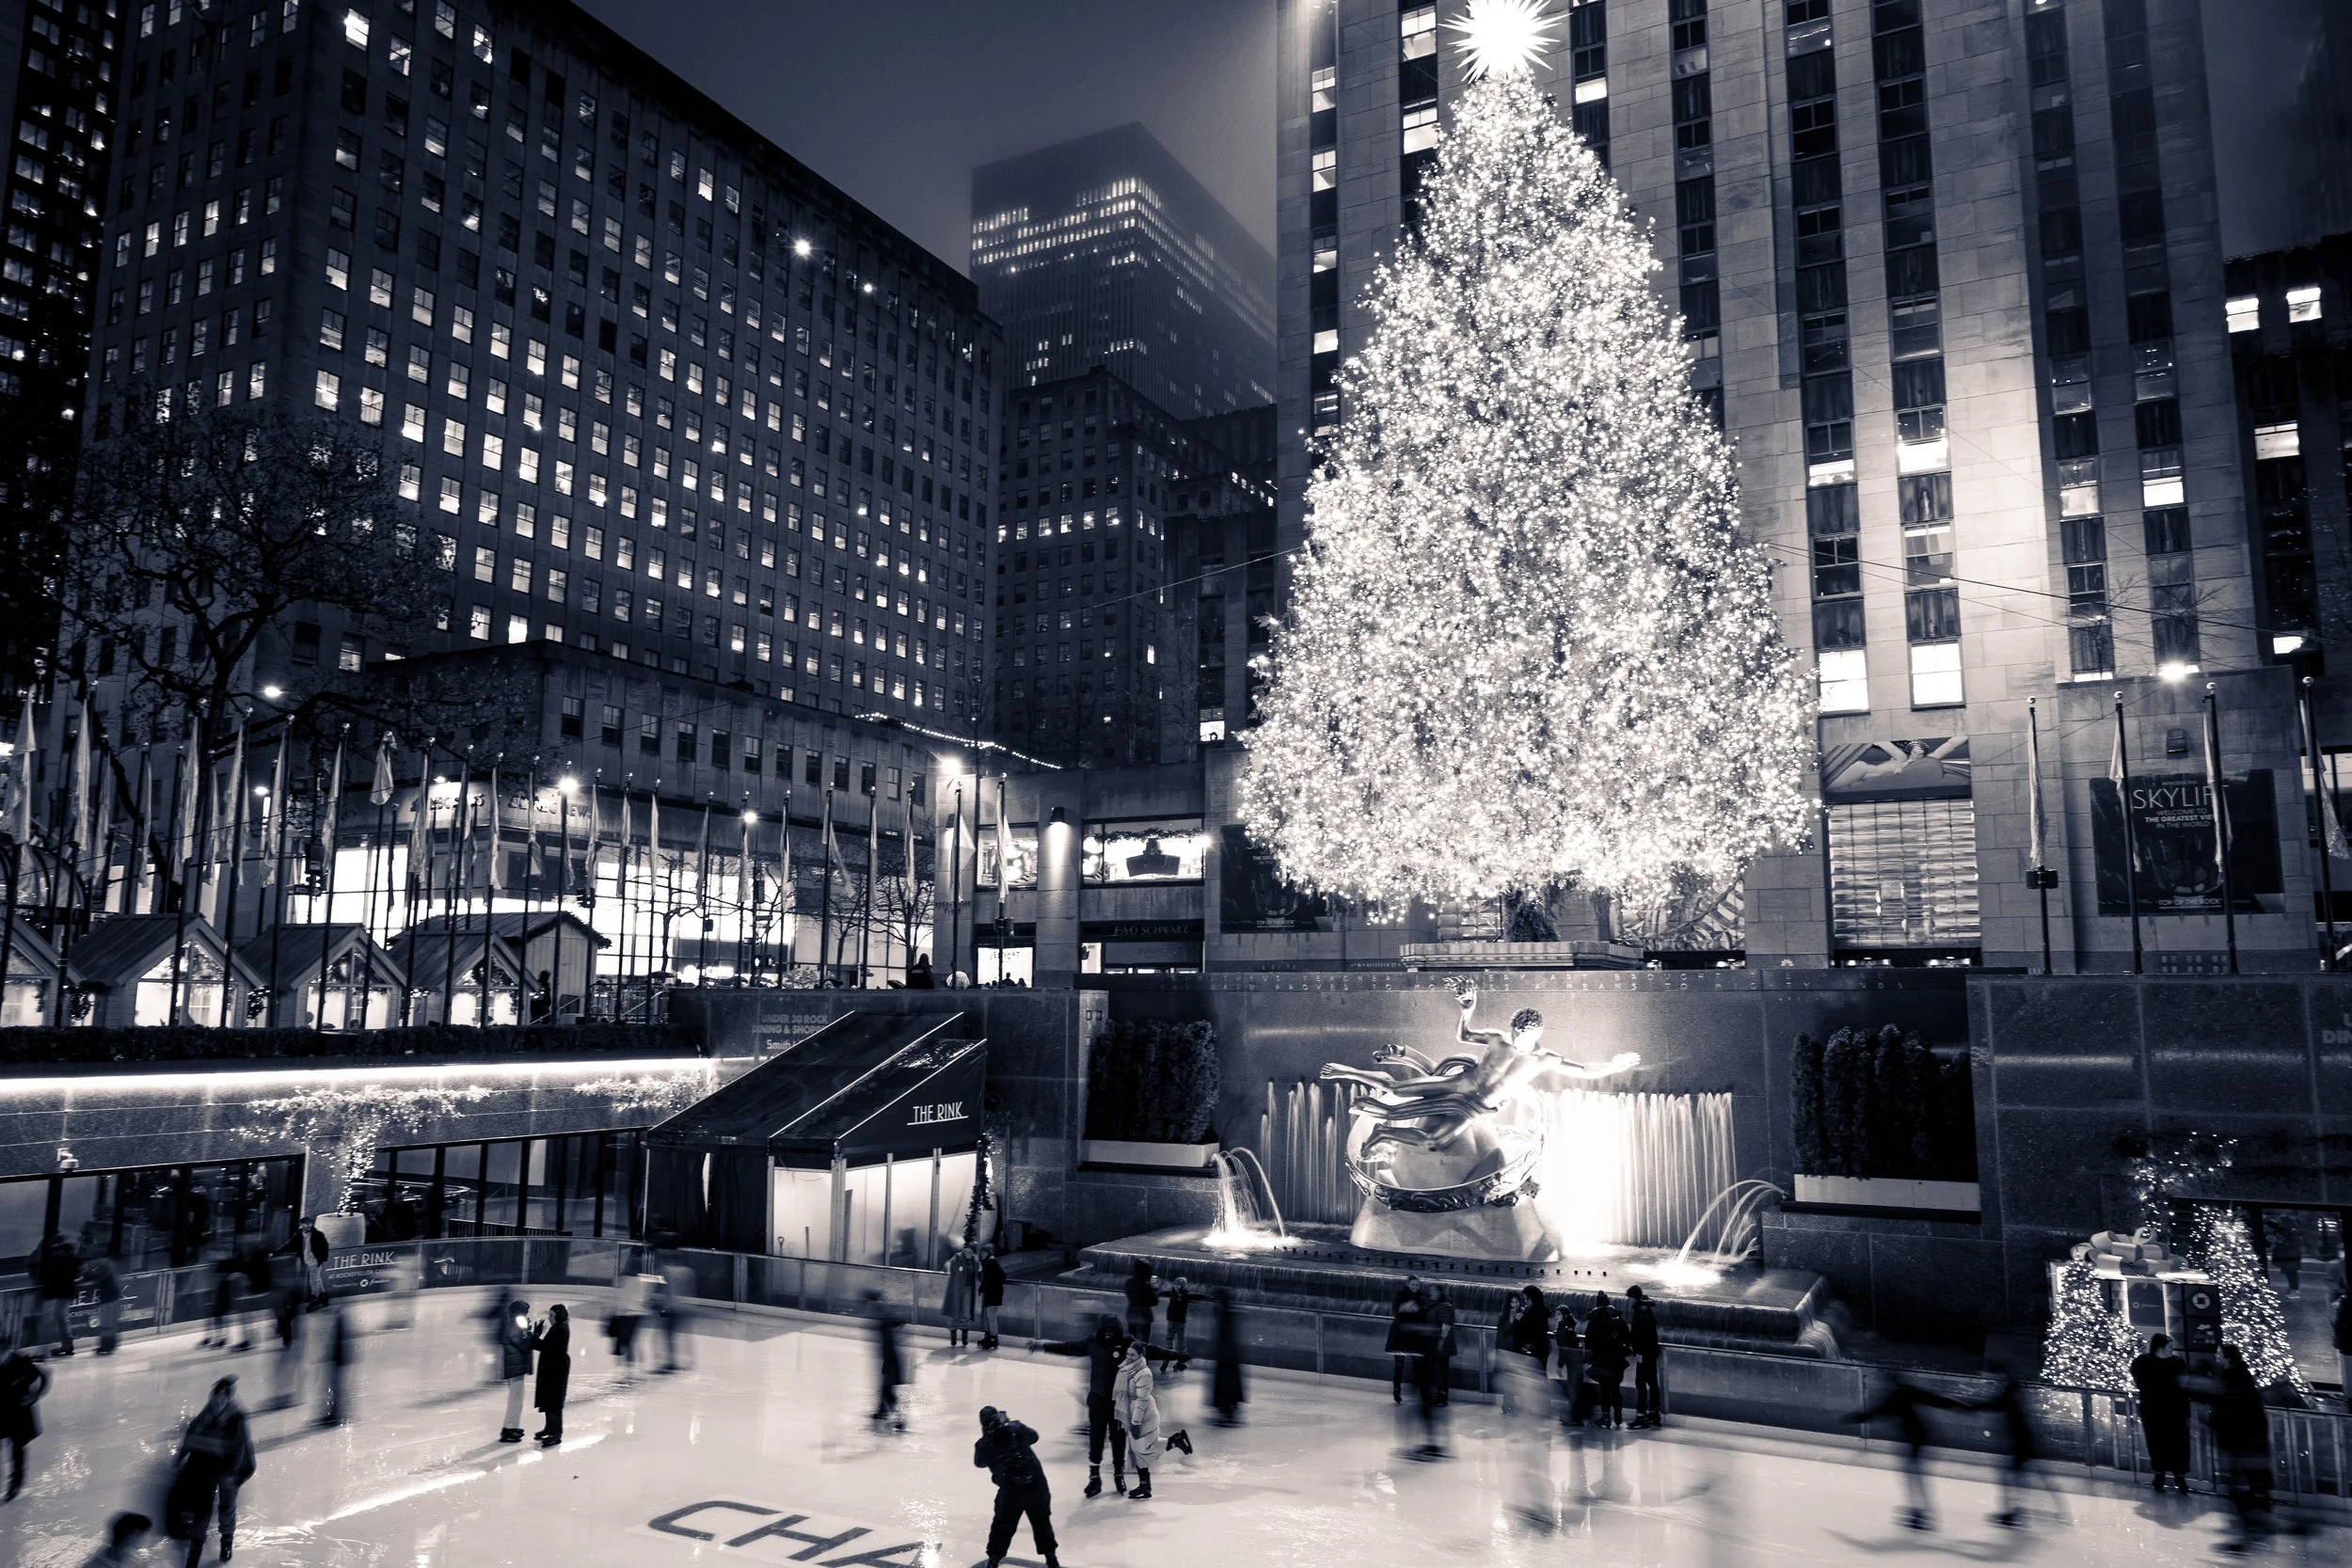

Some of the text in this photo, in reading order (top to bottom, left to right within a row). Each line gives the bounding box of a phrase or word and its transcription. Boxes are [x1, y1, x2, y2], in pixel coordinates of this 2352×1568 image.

[1114, 925, 1189, 935] FAO SCHWARZ
[1614, 973, 1721, 981] BROUGHT
[760, 1014, 828, 1024] UNDER 30 ROCK
[784, 1025, 790, 1034] &
[766, 1039, 791, 1050] Smith
[914, 1101, 963, 1124] THE RINK
[332, 1251, 395, 1270] THE RINK
